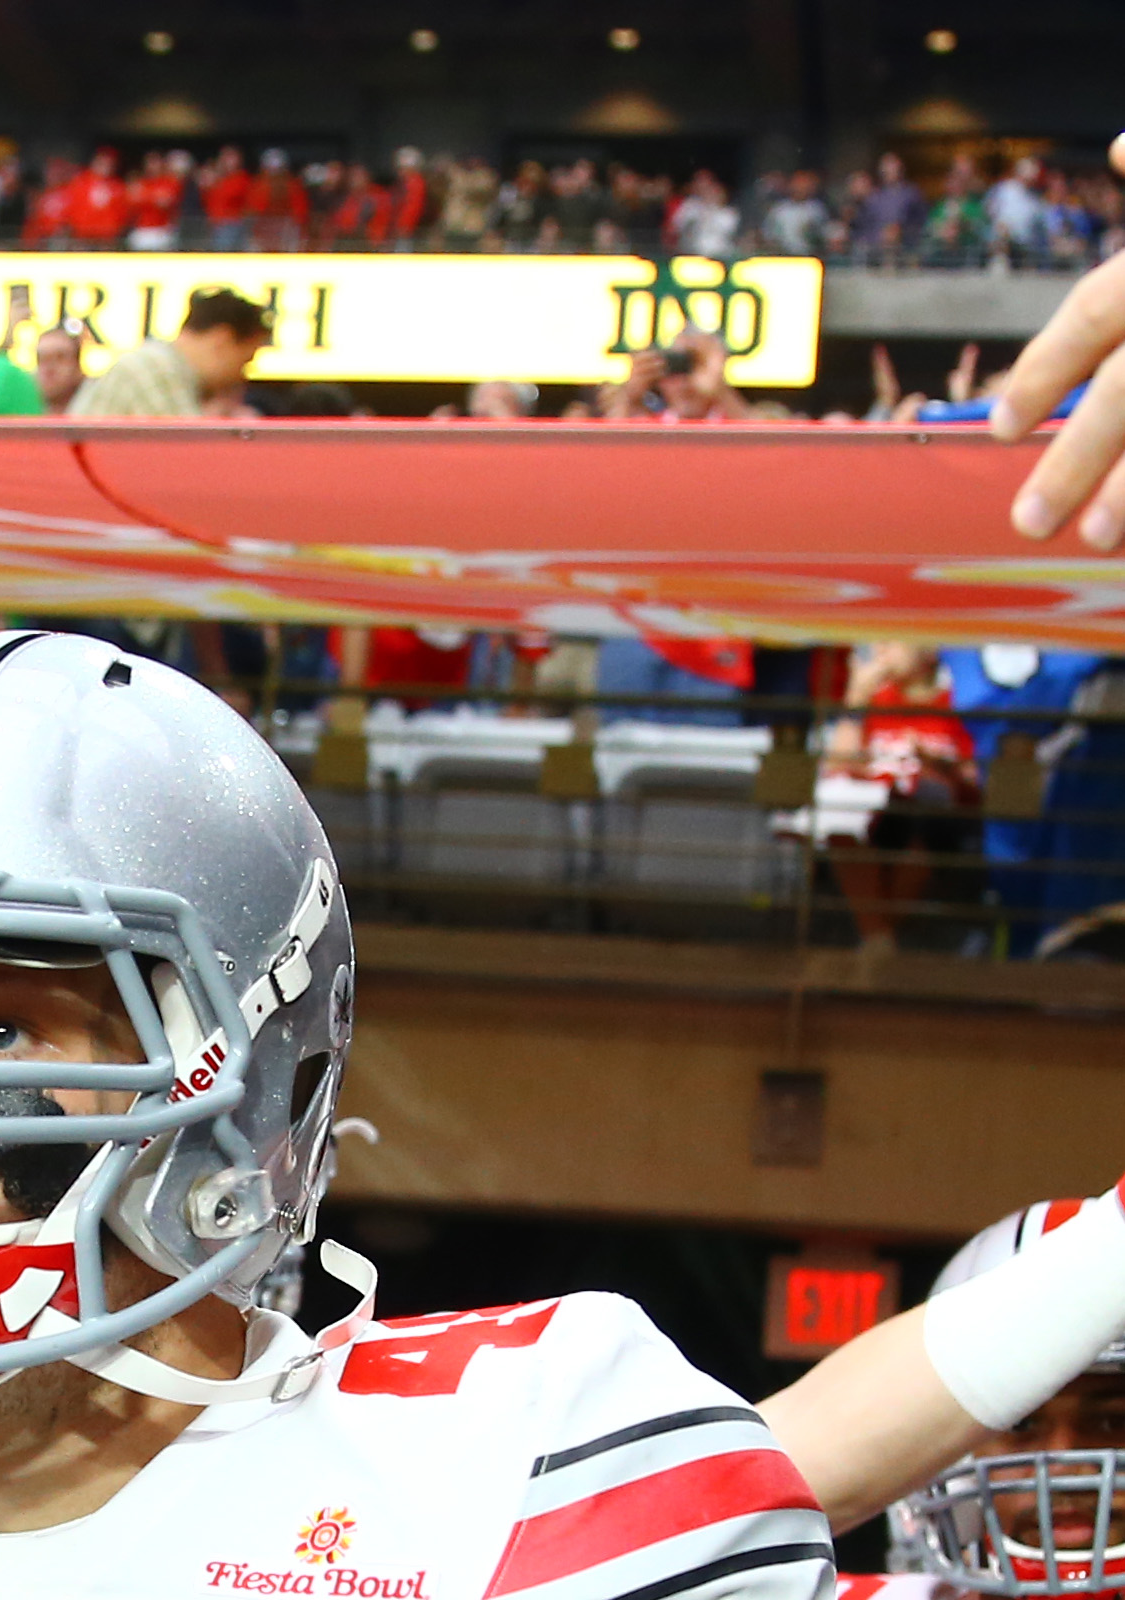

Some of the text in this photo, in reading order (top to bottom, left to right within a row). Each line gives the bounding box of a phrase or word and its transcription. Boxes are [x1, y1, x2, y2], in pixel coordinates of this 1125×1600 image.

[786, 1268, 884, 1344] EXIT
[206, 1561, 431, 1600] Fiesta Bowl
